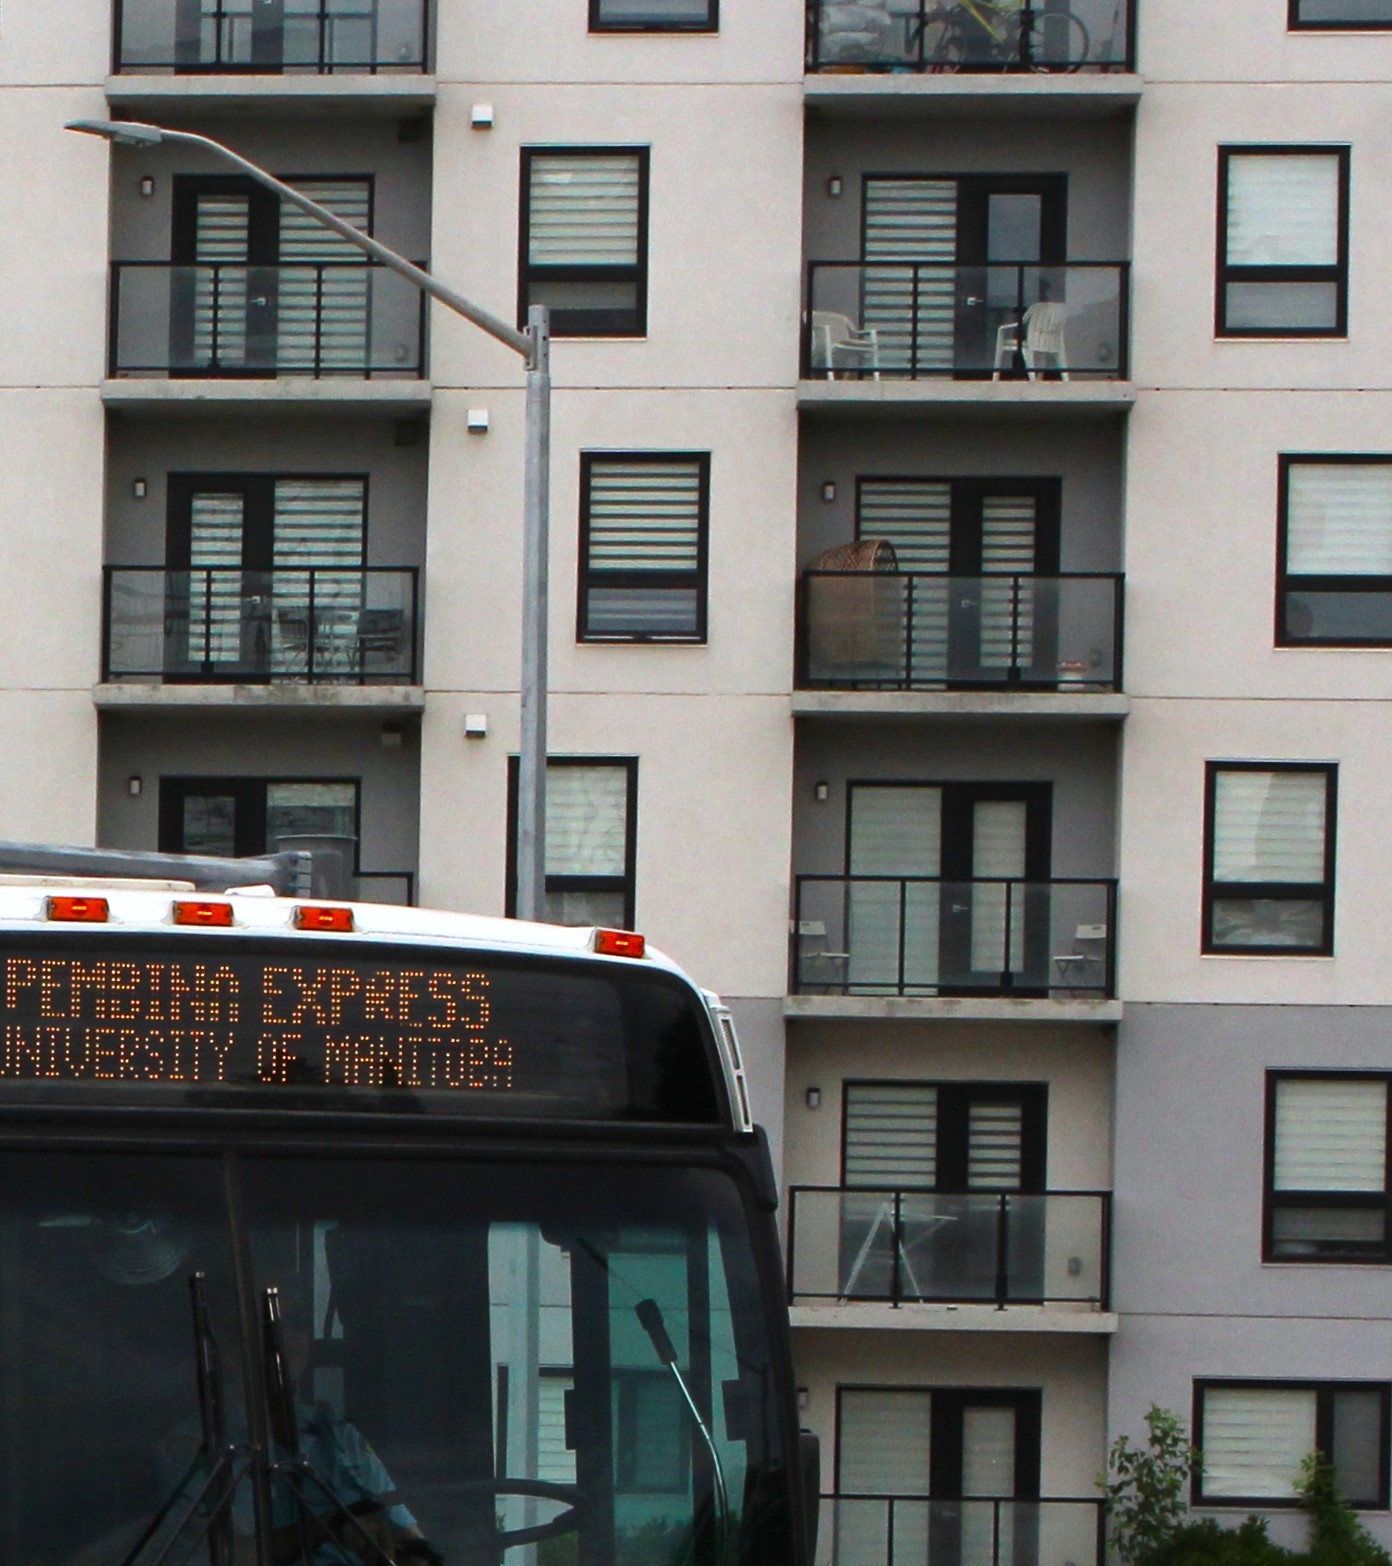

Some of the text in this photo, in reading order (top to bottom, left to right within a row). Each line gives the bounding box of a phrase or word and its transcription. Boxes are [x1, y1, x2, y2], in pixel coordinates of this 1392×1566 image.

[7, 959, 490, 1030] PEMBINA EXPRESS
[257, 1032, 302, 1084] OF
[324, 1034, 513, 1088] MANITOBA
